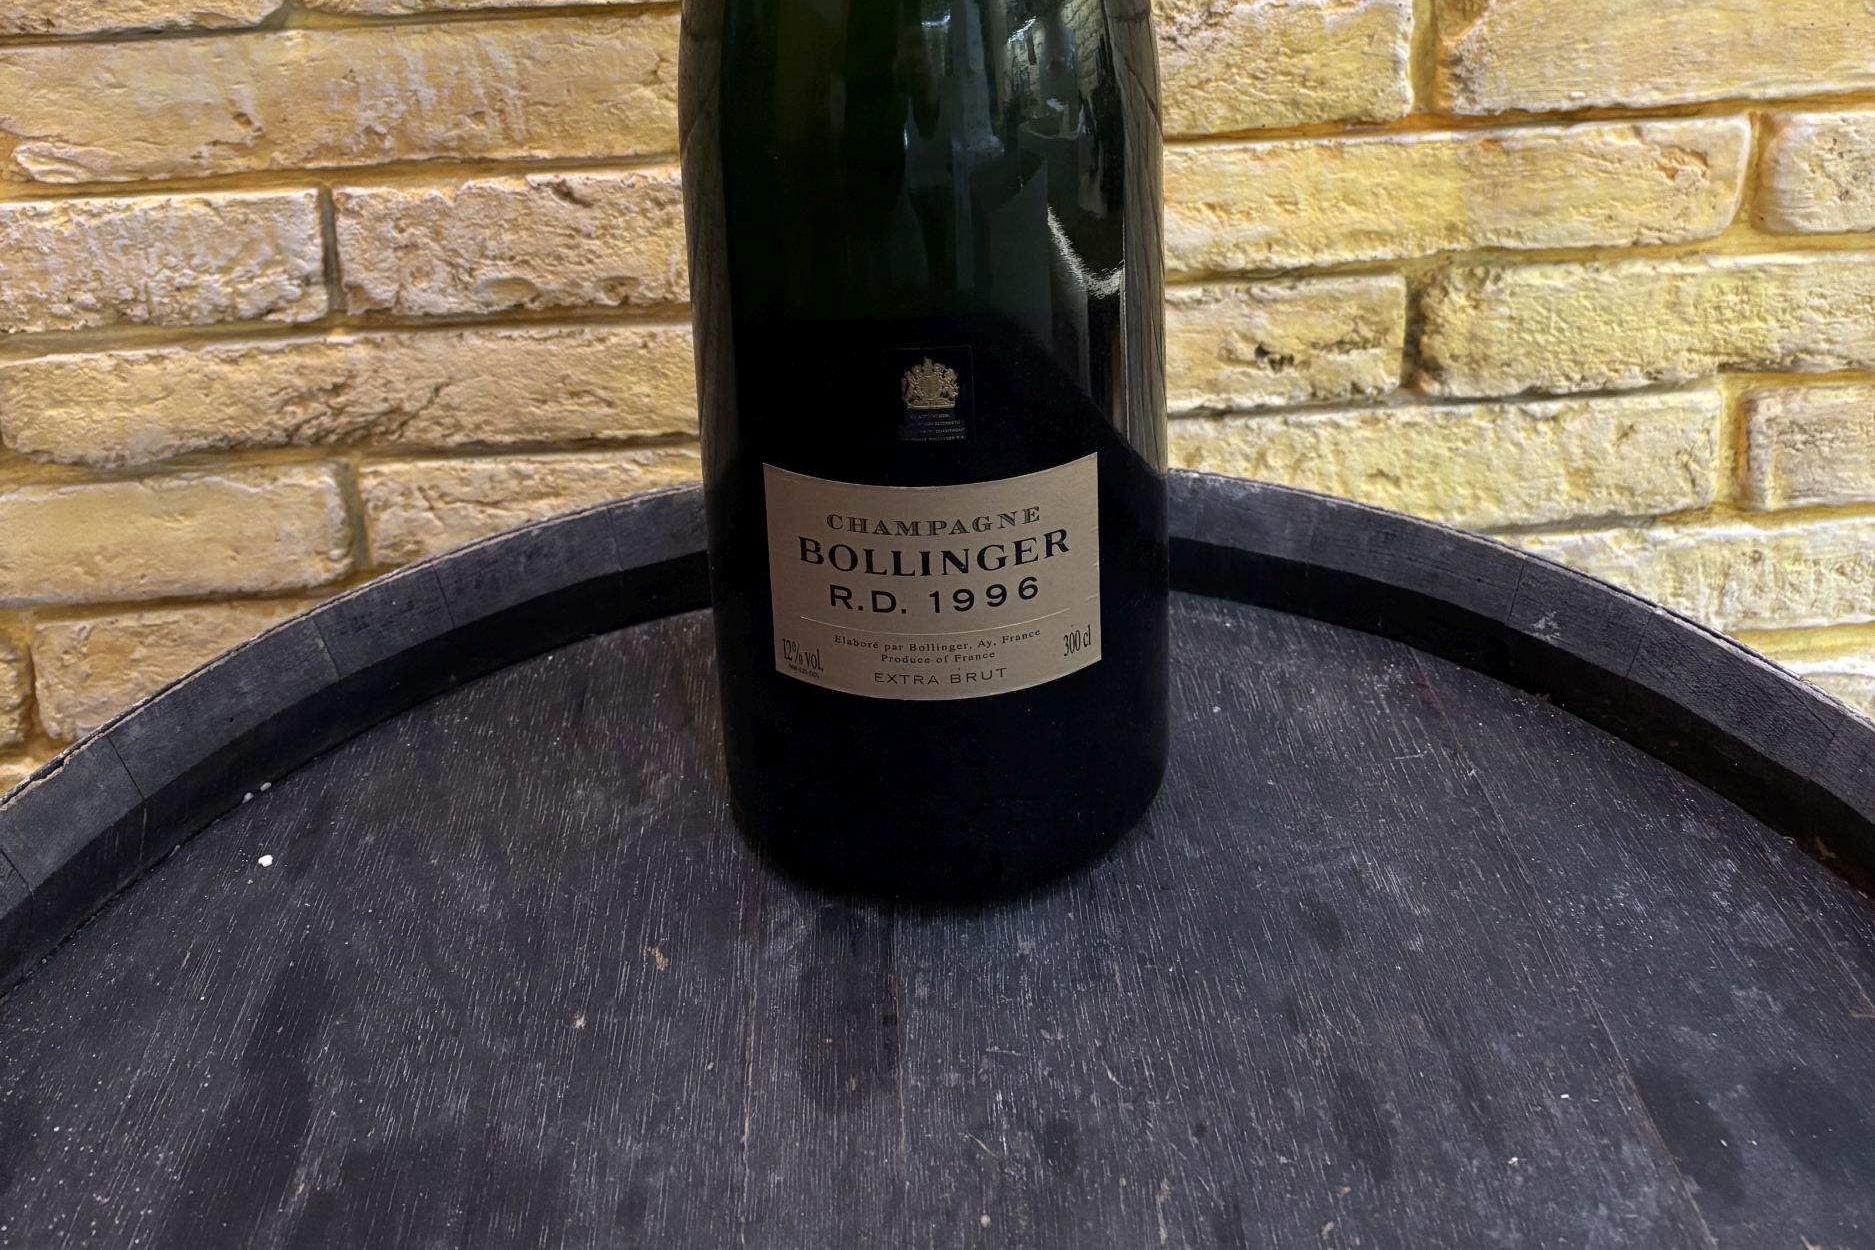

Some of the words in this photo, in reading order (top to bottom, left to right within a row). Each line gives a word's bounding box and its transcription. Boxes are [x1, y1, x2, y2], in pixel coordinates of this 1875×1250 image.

[826, 505, 1041, 537] CHAMPAGNE
[798, 527, 1071, 578] BOLLINGER
[829, 583, 907, 614] R.D.
[929, 576, 1039, 614] 1996
[781, 638, 804, 666] 12%
[804, 648, 824, 672] vol.
[834, 634, 879, 649] Elaboré
[884, 643, 904, 652] par
[1002, 628, 1041, 644] France
[1063, 633, 1081, 657] 300
[1083, 624, 1092, 648] cl
[881, 653, 931, 664] Produce
[936, 652, 949, 664] of
[954, 650, 996, 663] France
[874, 672, 940, 686] EXTRA
[950, 667, 1008, 684] BRUT
